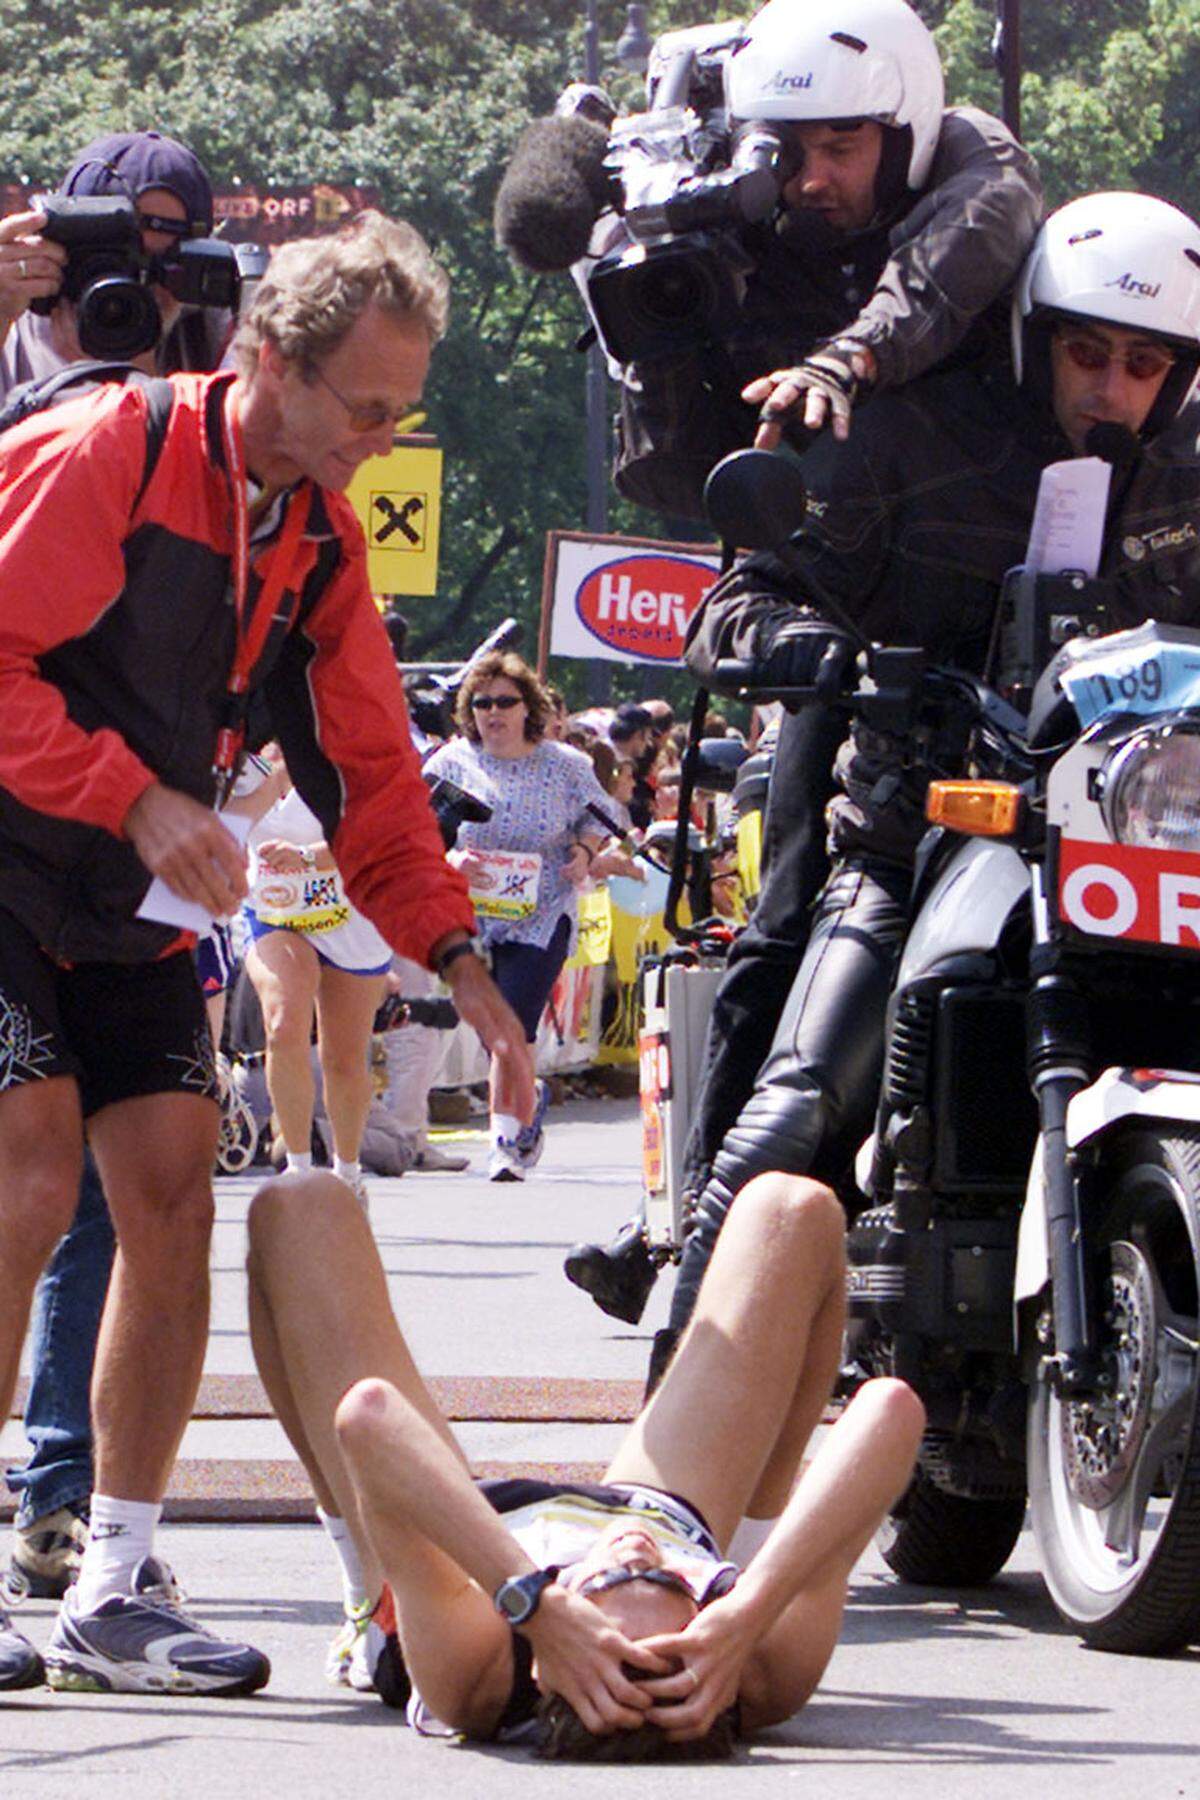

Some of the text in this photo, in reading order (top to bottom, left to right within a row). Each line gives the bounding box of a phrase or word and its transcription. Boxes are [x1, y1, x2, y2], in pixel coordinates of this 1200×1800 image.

[761, 69, 813, 89] Arai
[263, 197, 311, 217] ORF
[1103, 272, 1161, 298] Arai
